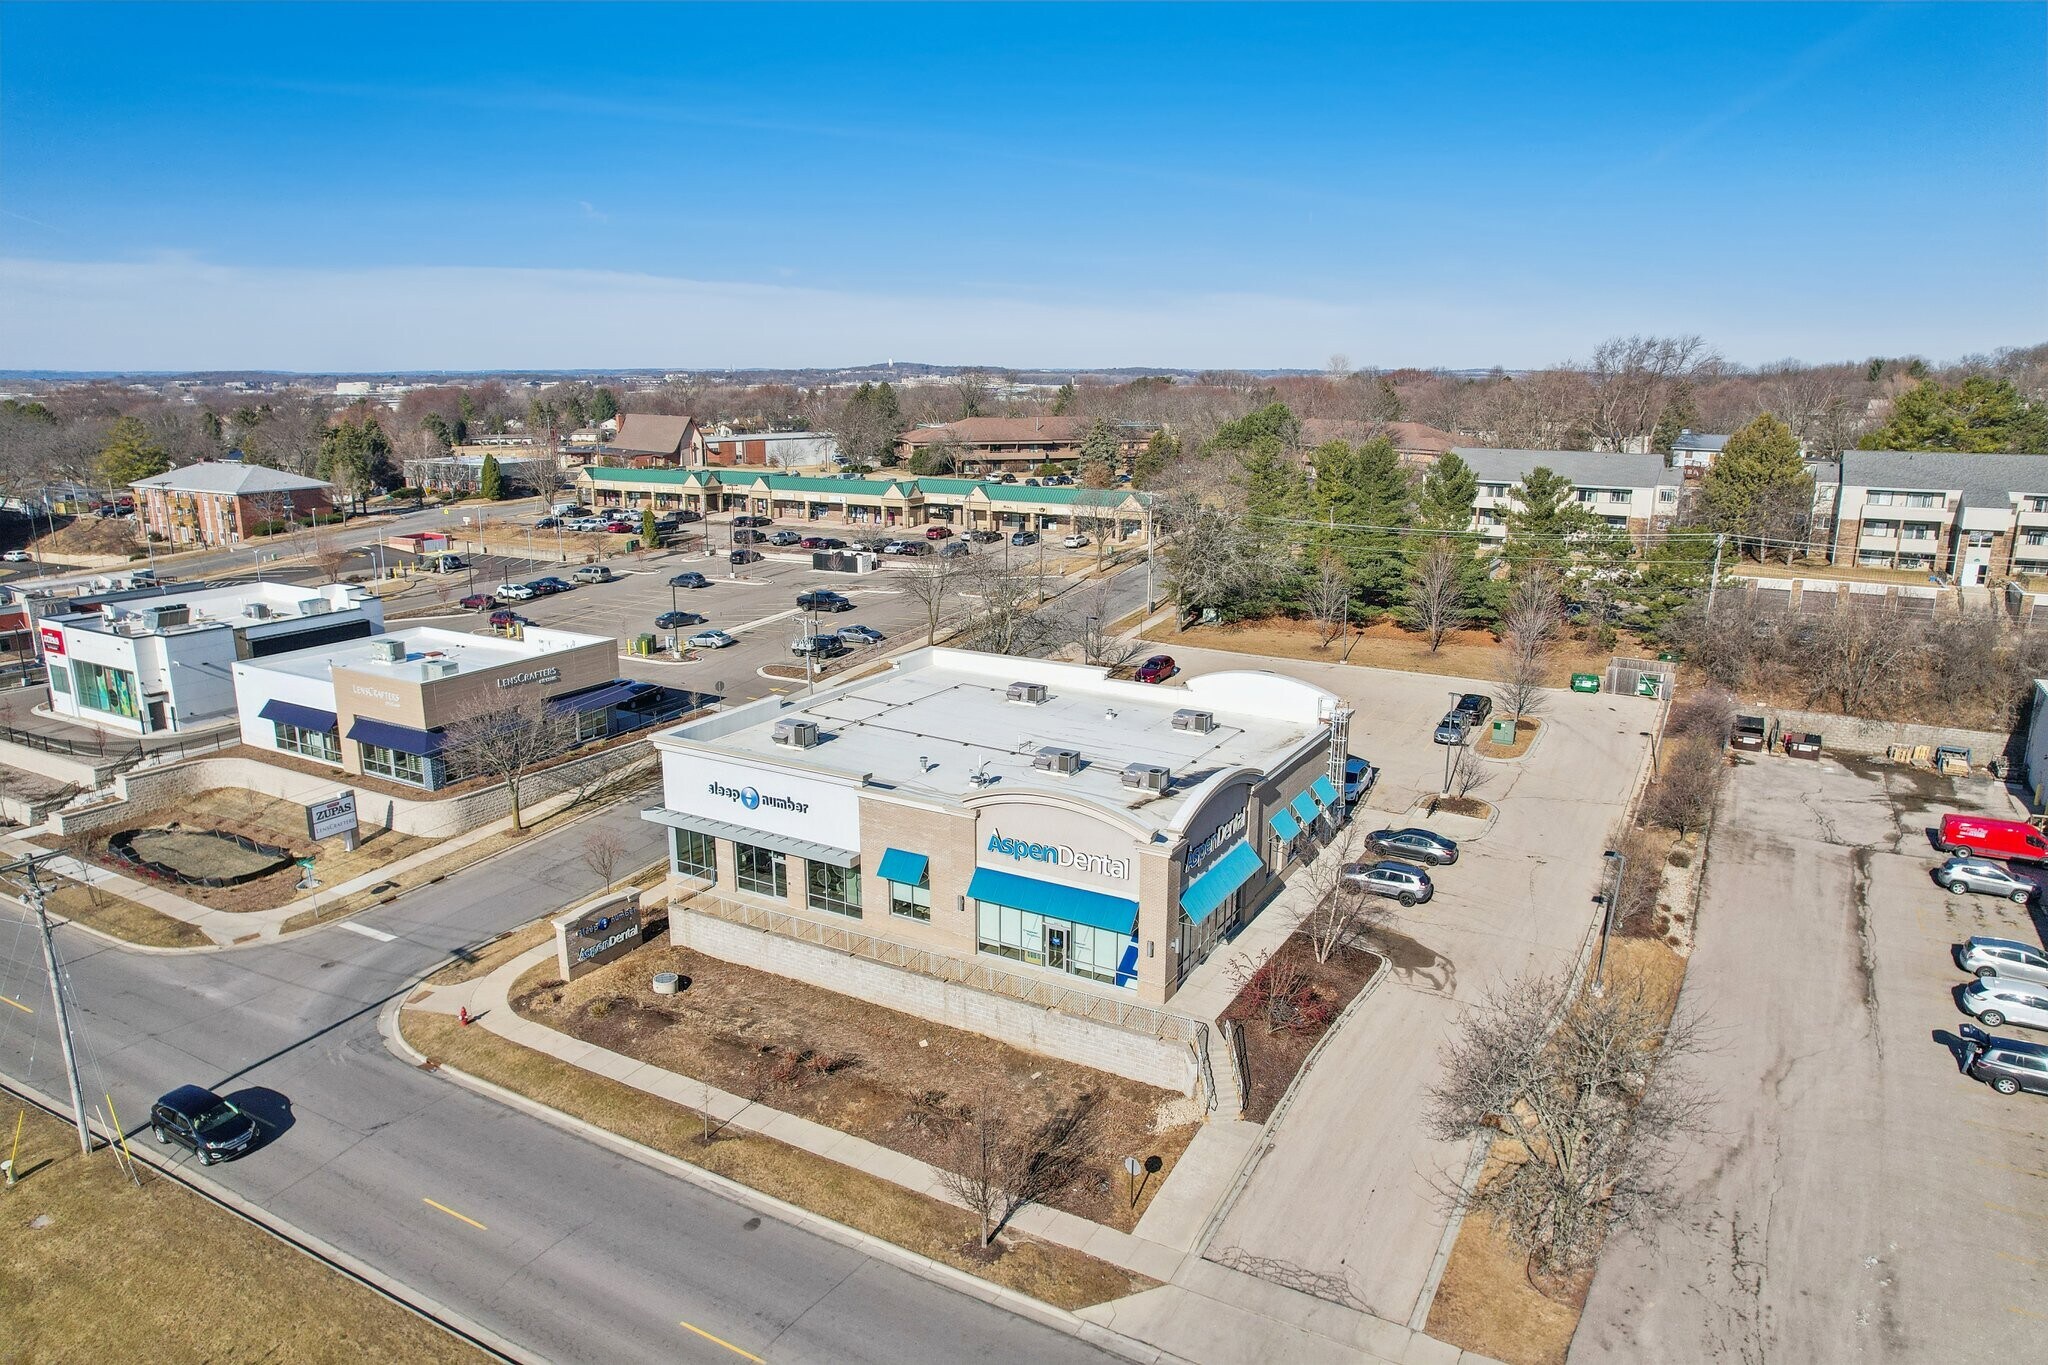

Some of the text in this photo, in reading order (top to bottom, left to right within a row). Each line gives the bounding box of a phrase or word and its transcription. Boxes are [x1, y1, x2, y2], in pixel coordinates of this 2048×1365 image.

[708, 781, 809, 814] sleep number
[316, 803, 352, 821] ZUPAS
